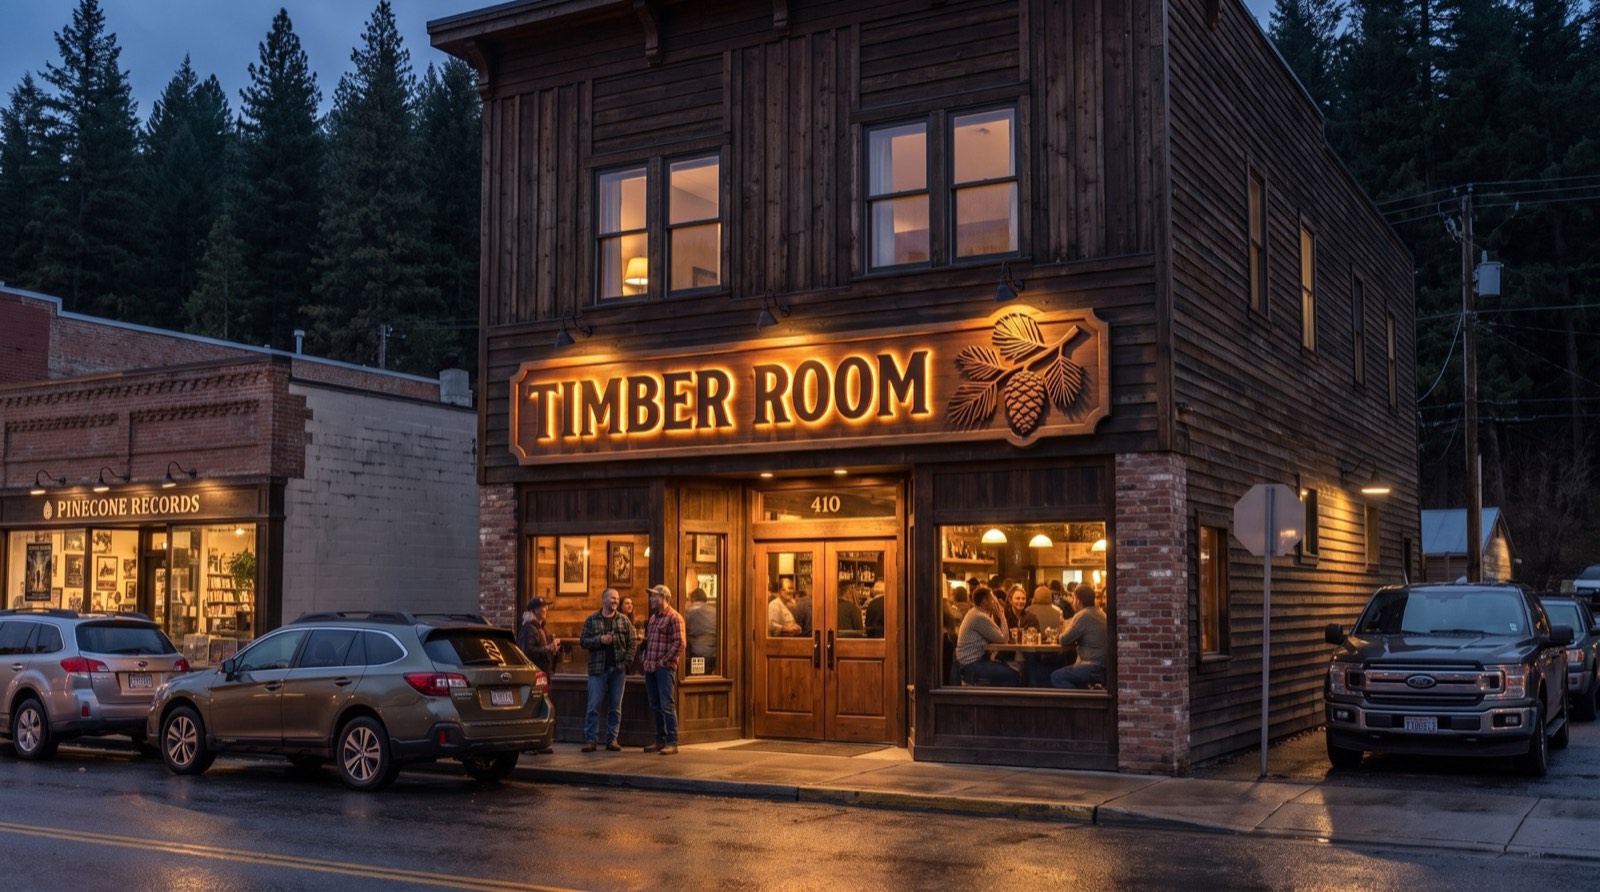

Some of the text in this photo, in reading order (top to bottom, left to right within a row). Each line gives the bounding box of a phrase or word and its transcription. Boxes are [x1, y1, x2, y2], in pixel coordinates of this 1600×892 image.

[529, 350, 933, 440] TIMBER ROOM
[57, 495, 199, 518] PINECONE RECORDS
[811, 496, 841, 513] 410
